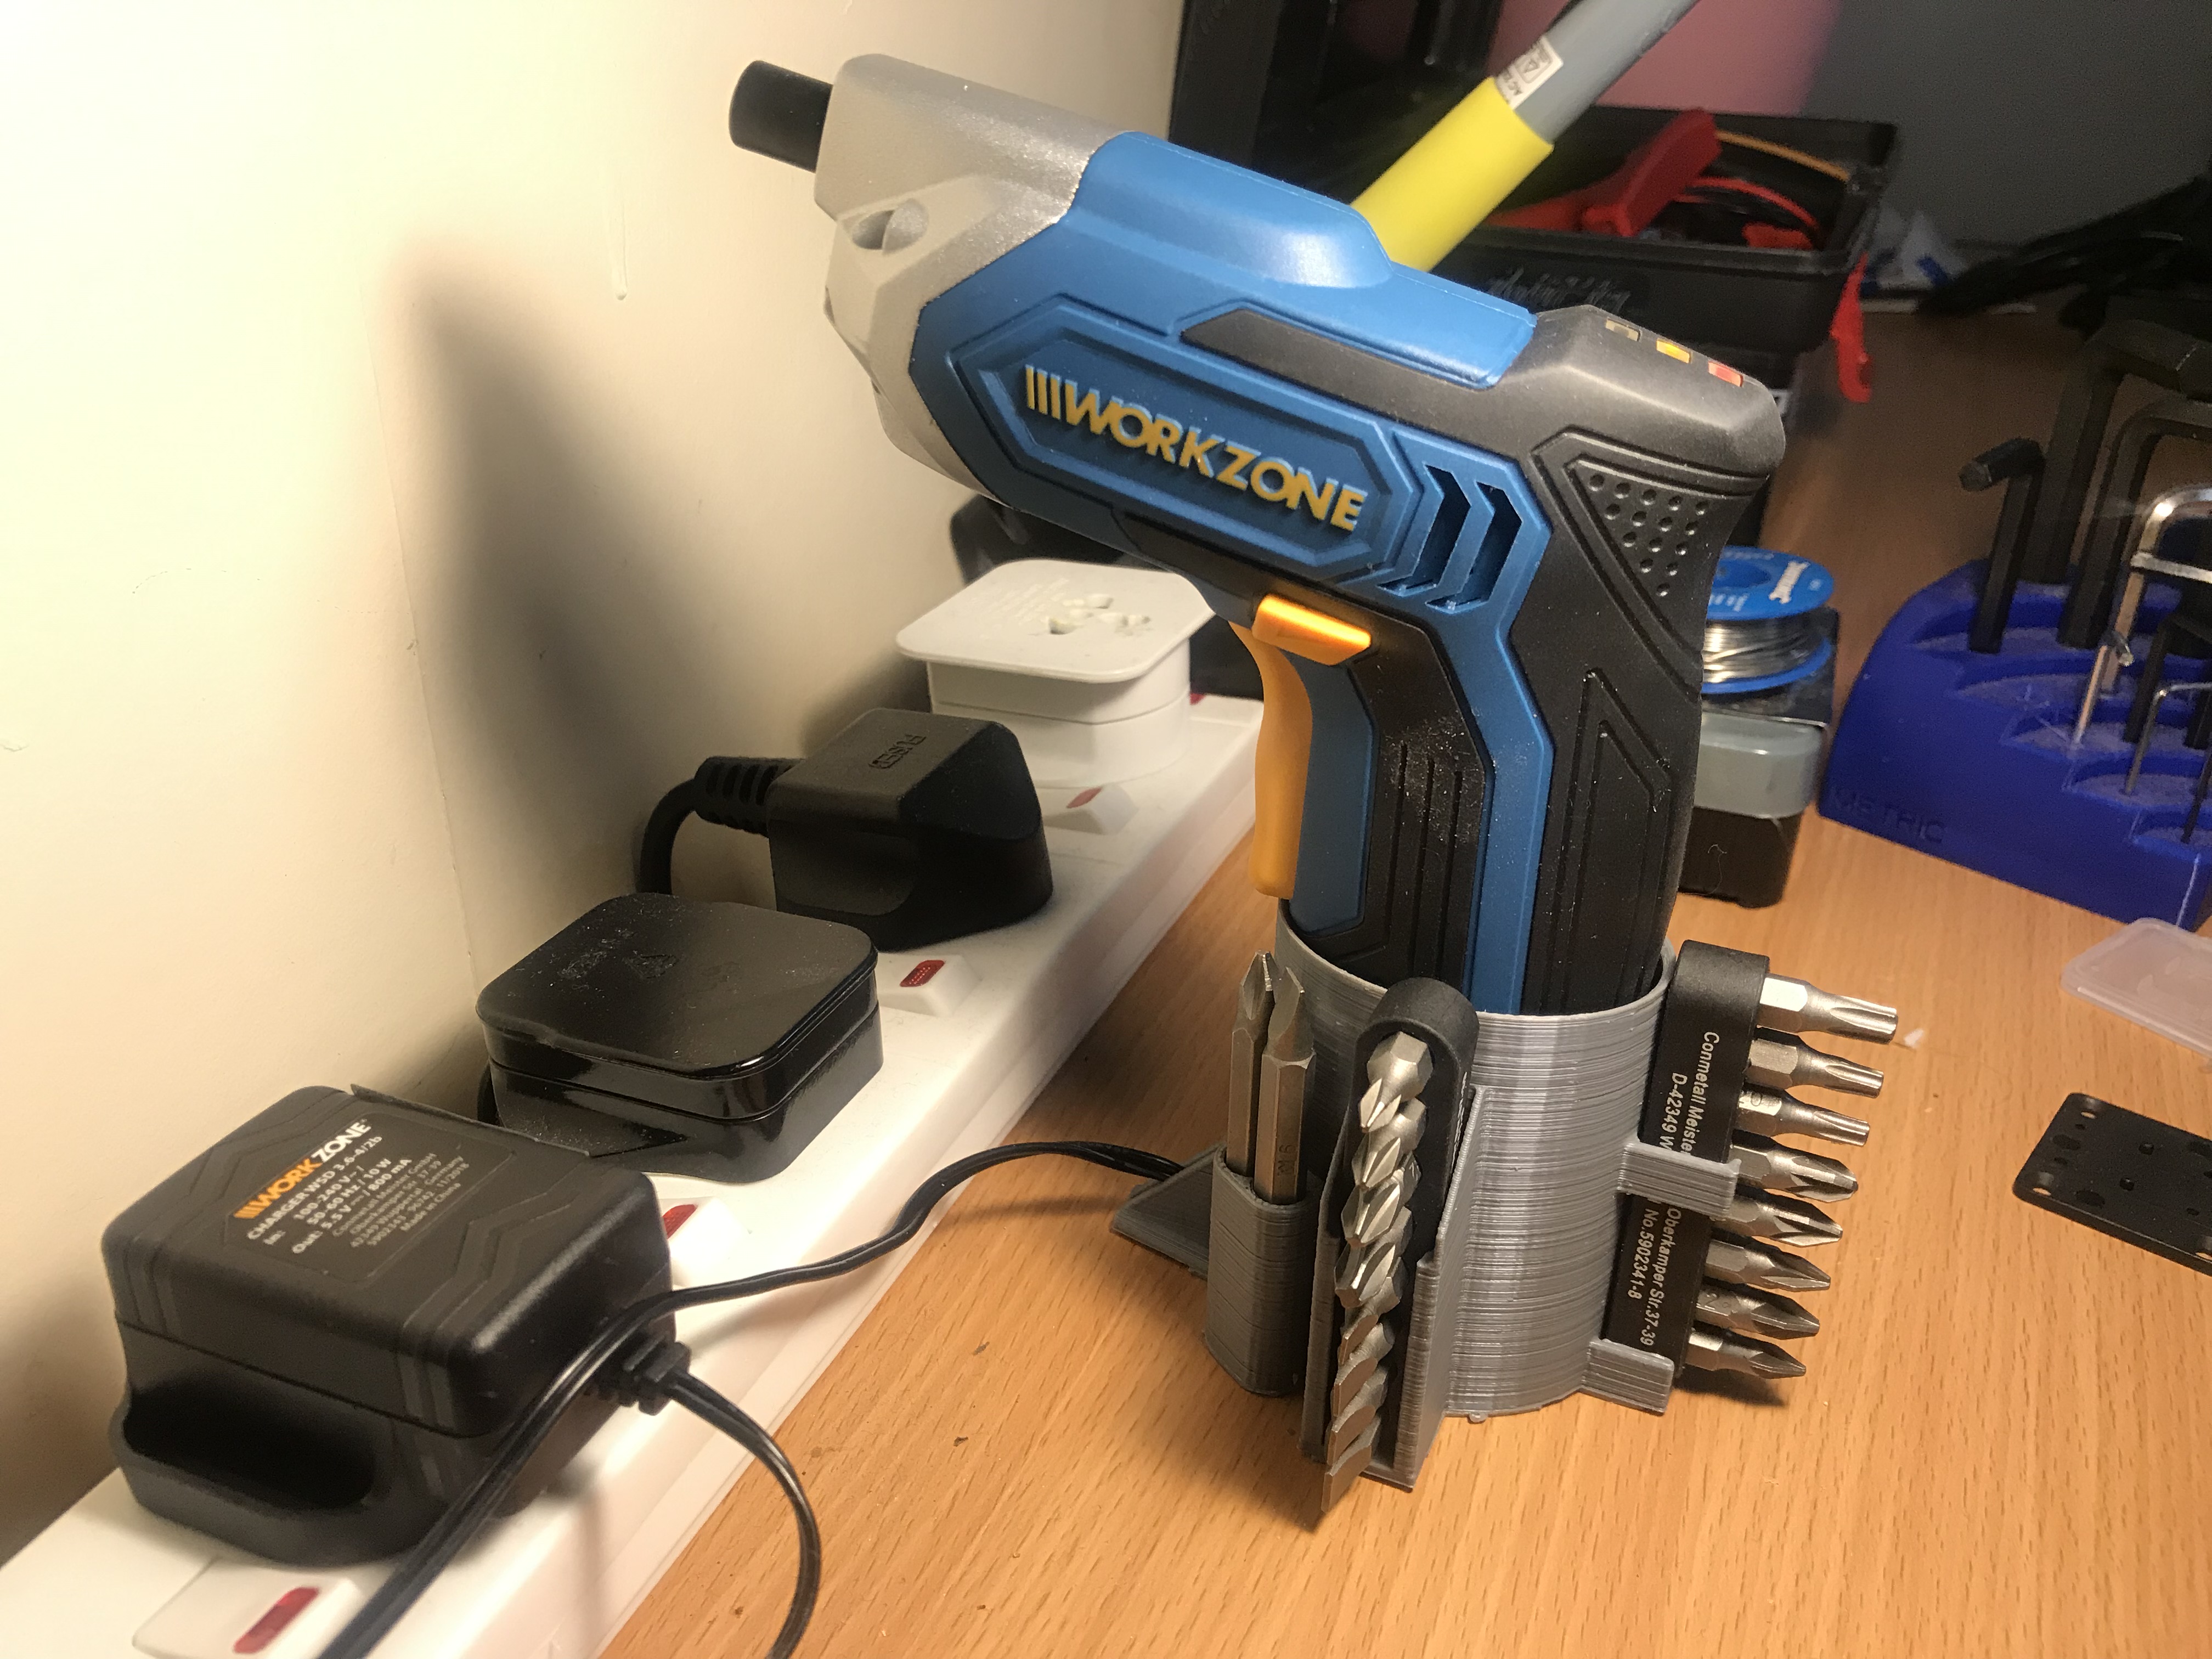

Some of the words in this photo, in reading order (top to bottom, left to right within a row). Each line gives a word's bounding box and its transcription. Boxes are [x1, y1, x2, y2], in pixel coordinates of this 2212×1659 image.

[1064, 379, 1368, 531] WORKZONE
[1691, 1031, 1720, 1103] Conmetall
[1661, 1073, 1688, 1132] D-42349
[247, 1192, 310, 1239] CHARGER
[303, 1170, 336, 1192] WSD
[294, 1183, 342, 1220] 100-240
[306, 1197, 344, 1224] 50-60
[363, 1168, 380, 1178] 10
[320, 1212, 343, 1229] 5.5
[368, 1173, 392, 1191] 800
[390, 1159, 412, 1174] mA
[1651, 1207, 1681, 1288] Oberkamper
